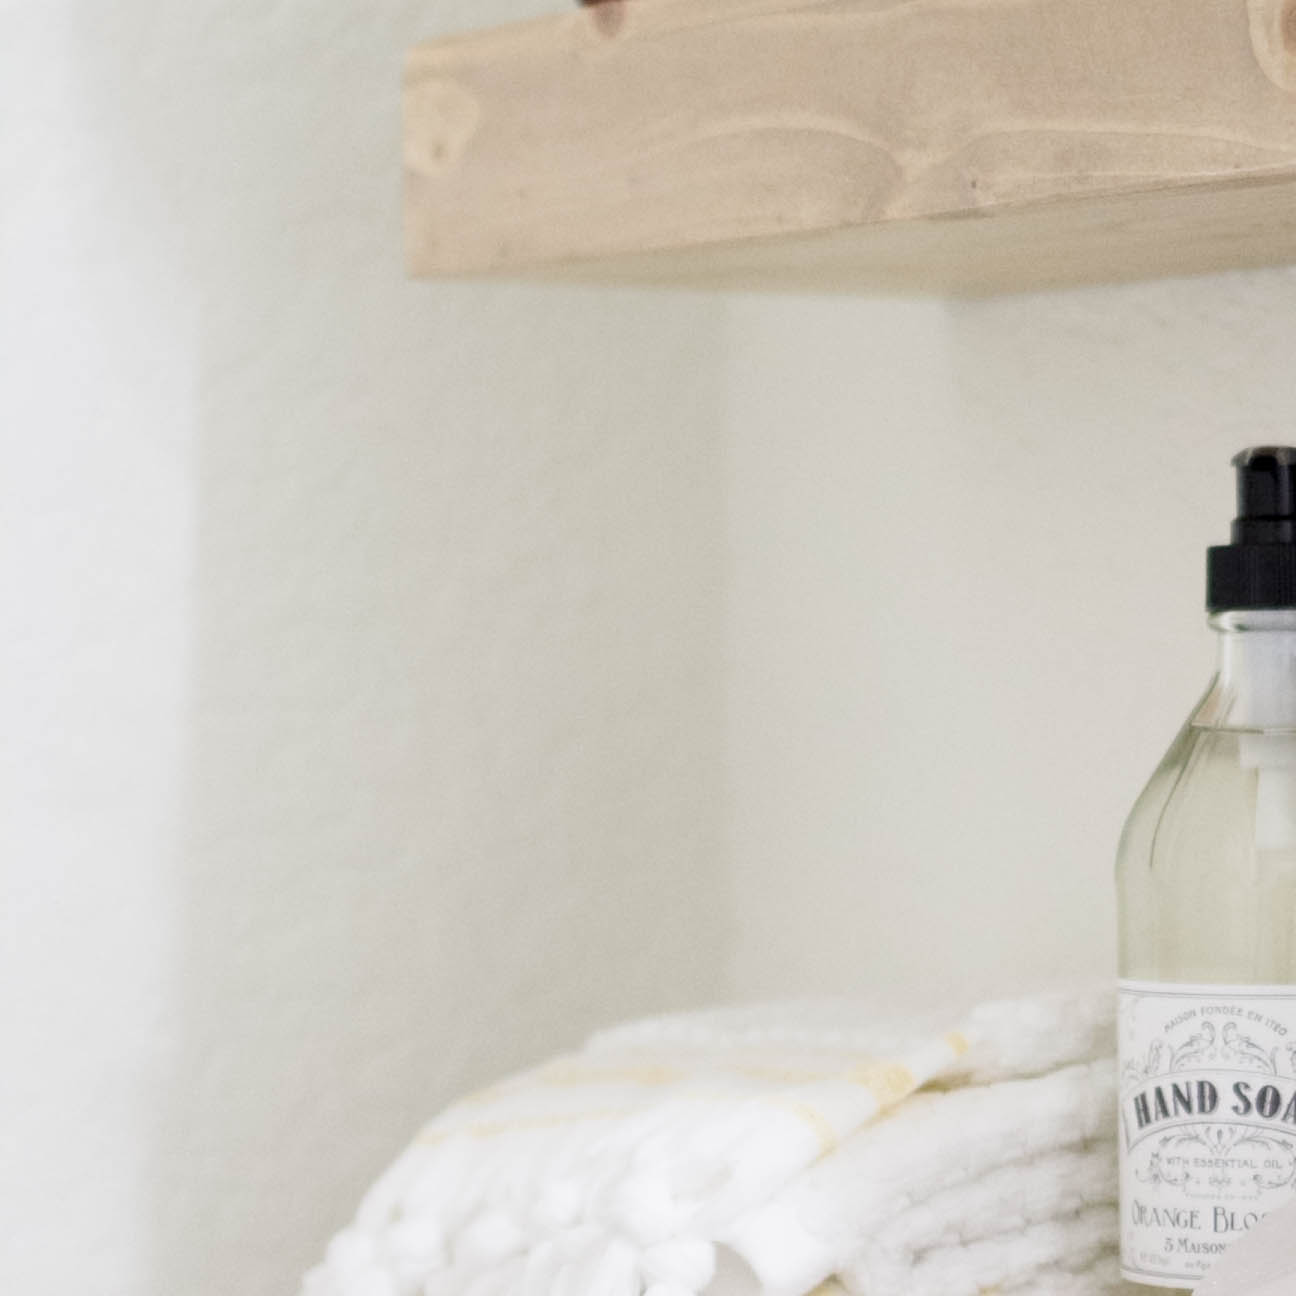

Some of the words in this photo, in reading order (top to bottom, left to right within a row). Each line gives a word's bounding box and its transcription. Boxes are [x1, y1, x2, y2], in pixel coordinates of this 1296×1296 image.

[1247, 1010, 1263, 1023] EN
[1133, 1079, 1219, 1130] HAND
[1193, 1157, 1258, 1169] ESSENTIAL
[1263, 1159, 1283, 1169] OIL
[1131, 1199, 1201, 1231] ORANGE
